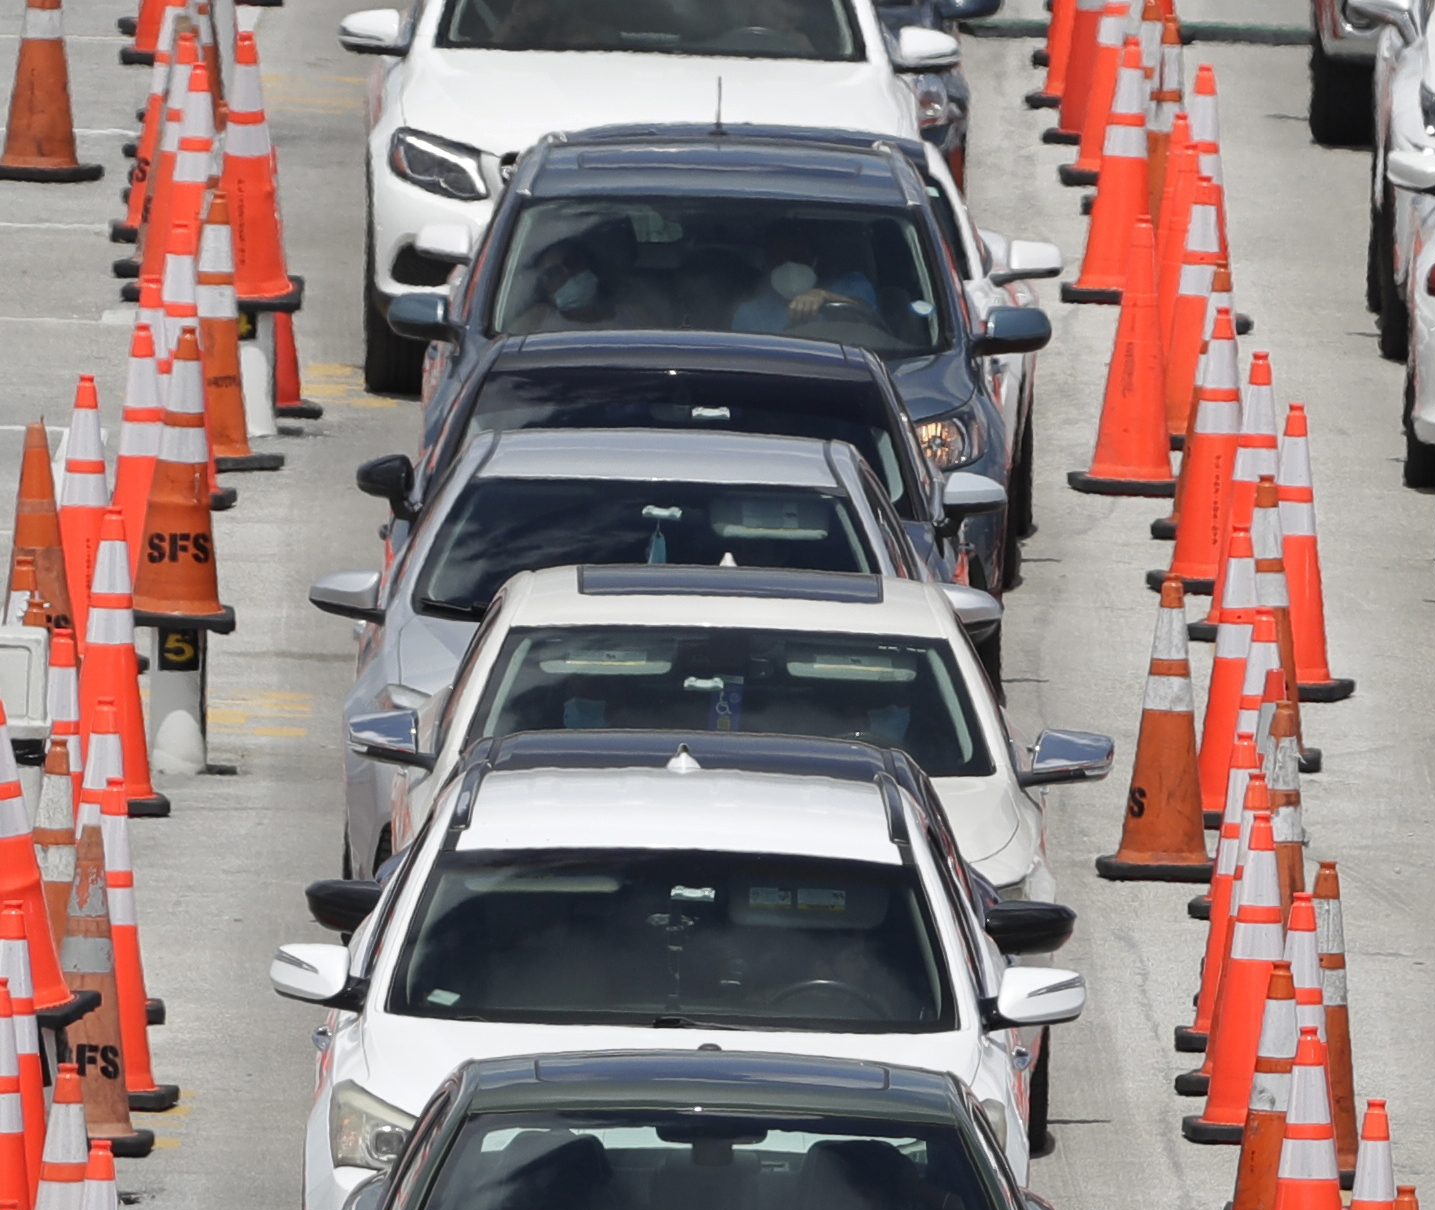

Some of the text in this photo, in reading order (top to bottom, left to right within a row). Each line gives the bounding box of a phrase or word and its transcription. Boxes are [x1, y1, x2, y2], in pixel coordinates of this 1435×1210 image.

[147, 532, 210, 564] SFS
[163, 633, 195, 663] 5
[76, 1043, 120, 1080] FS
